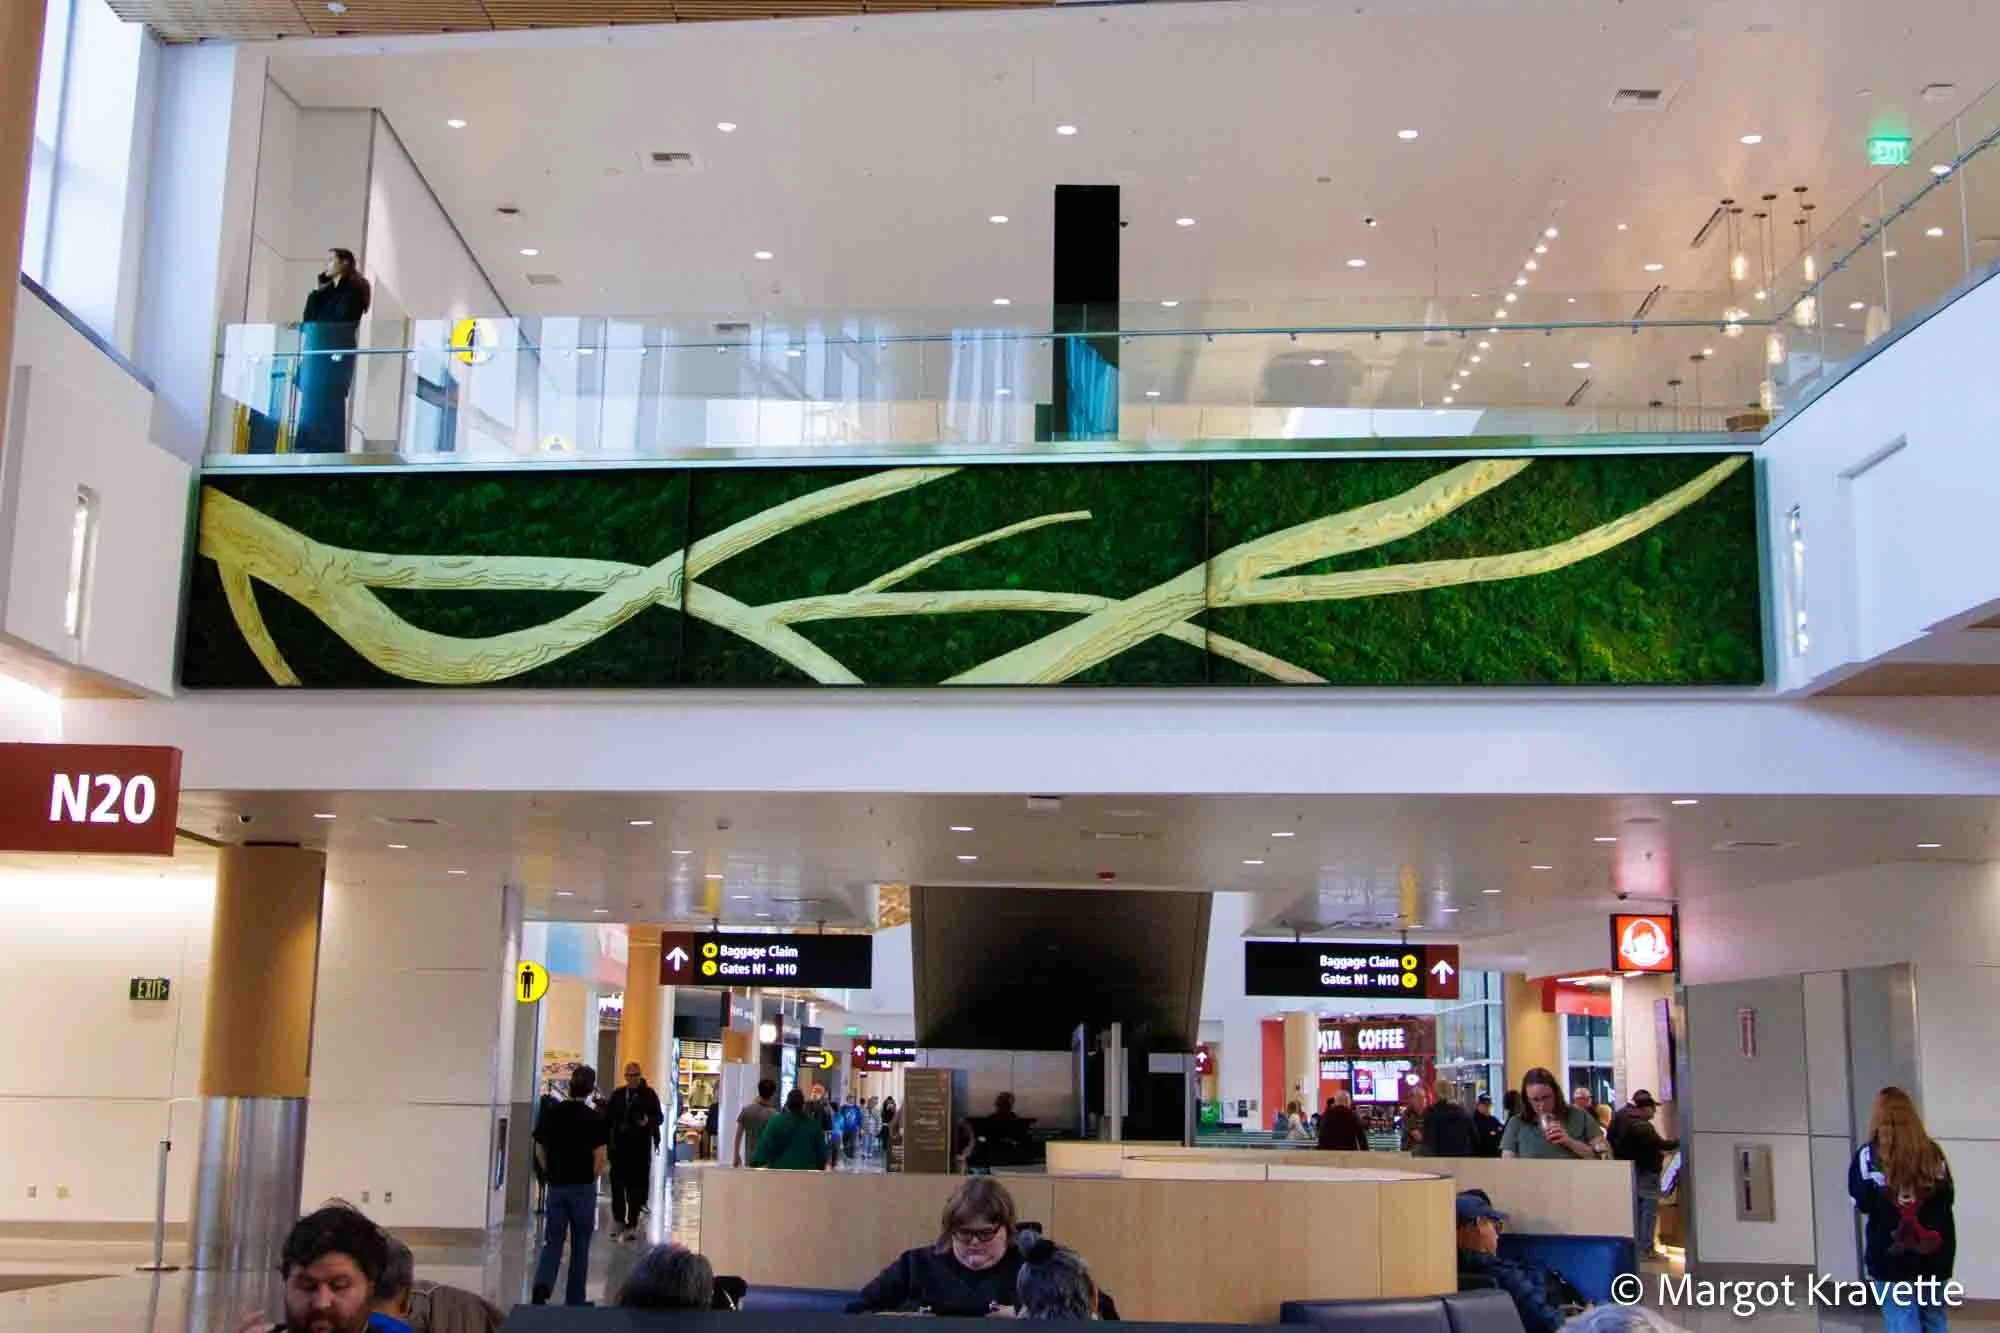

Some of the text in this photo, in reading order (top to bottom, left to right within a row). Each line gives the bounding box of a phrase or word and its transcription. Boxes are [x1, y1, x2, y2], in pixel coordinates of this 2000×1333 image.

[50, 773, 156, 825] N20
[720, 945, 798, 959] Baggage Claim
[719, 963, 750, 975] Gates
[753, 963, 766, 975] N1
[776, 964, 797, 975] N10
[1319, 955, 1399, 969] Baggage Claim
[1321, 973, 1352, 985] Gates
[1354, 974, 1368, 985] N1
[1378, 974, 1399, 986] N10
[138, 980, 164, 999] EXIT
[1358, 1028, 1405, 1050] COFFEE
